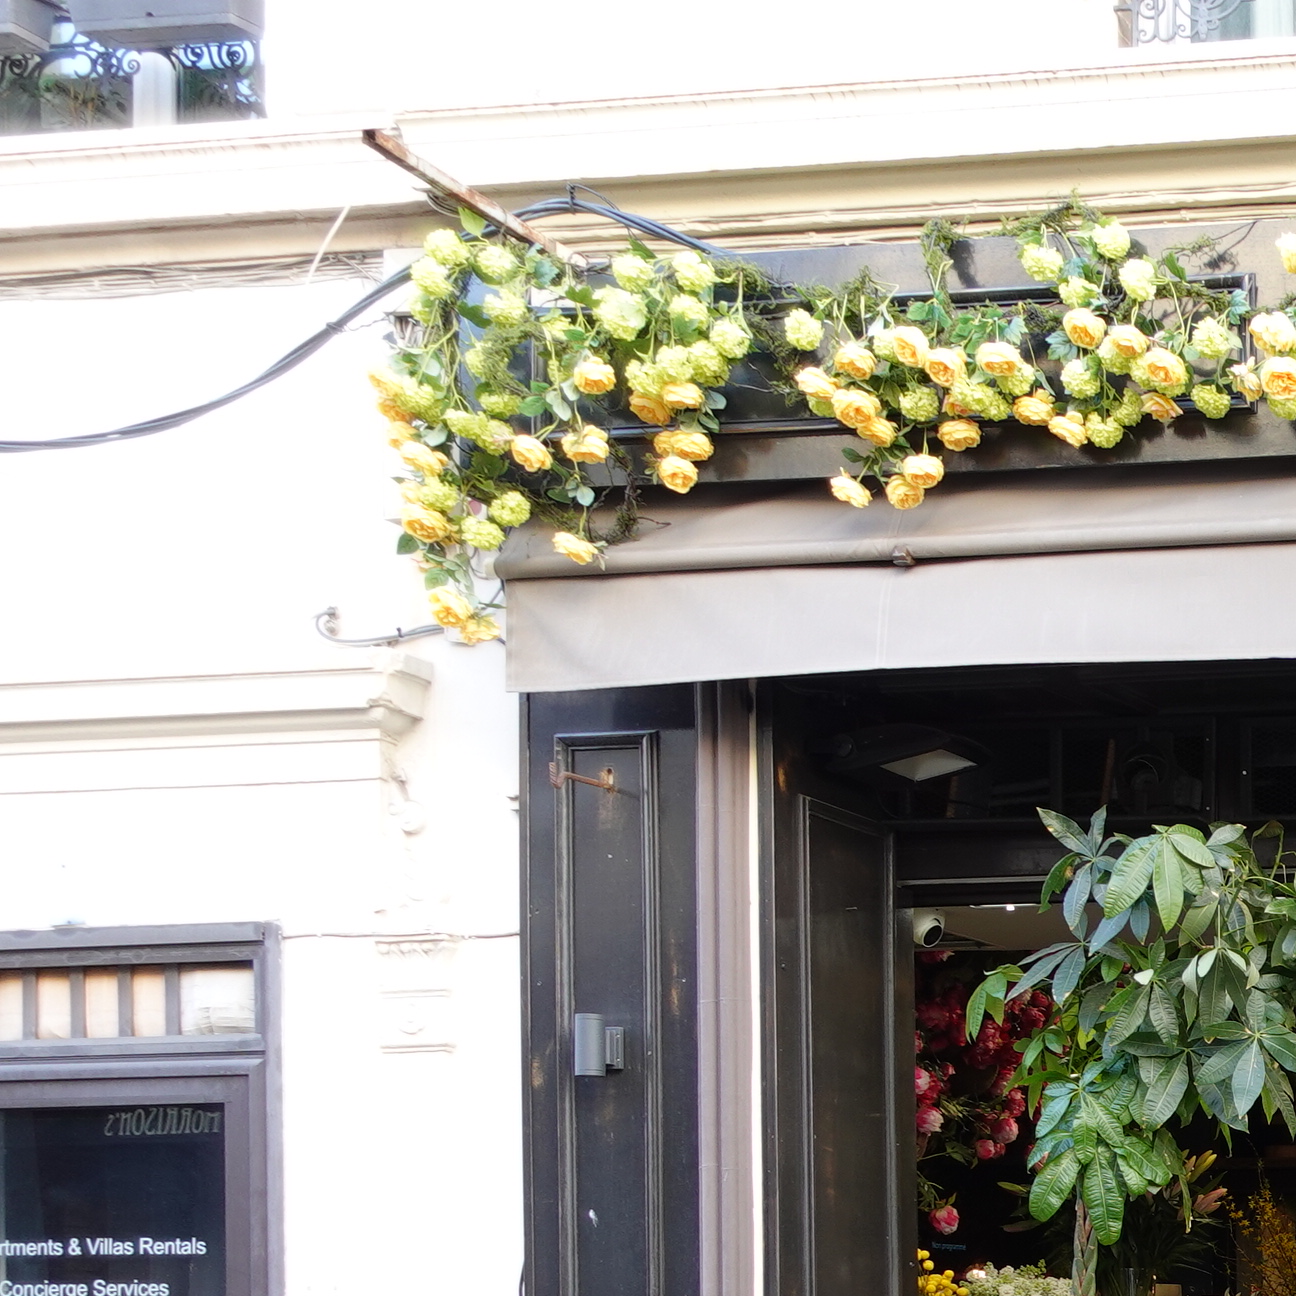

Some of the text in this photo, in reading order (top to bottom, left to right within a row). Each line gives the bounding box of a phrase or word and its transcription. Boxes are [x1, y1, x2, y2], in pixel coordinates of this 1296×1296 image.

[68, 1238, 82, 1255] &
[86, 1237, 134, 1255] Villas
[139, 1237, 207, 1255] Rentals
[93, 1279, 170, 1296] Services
